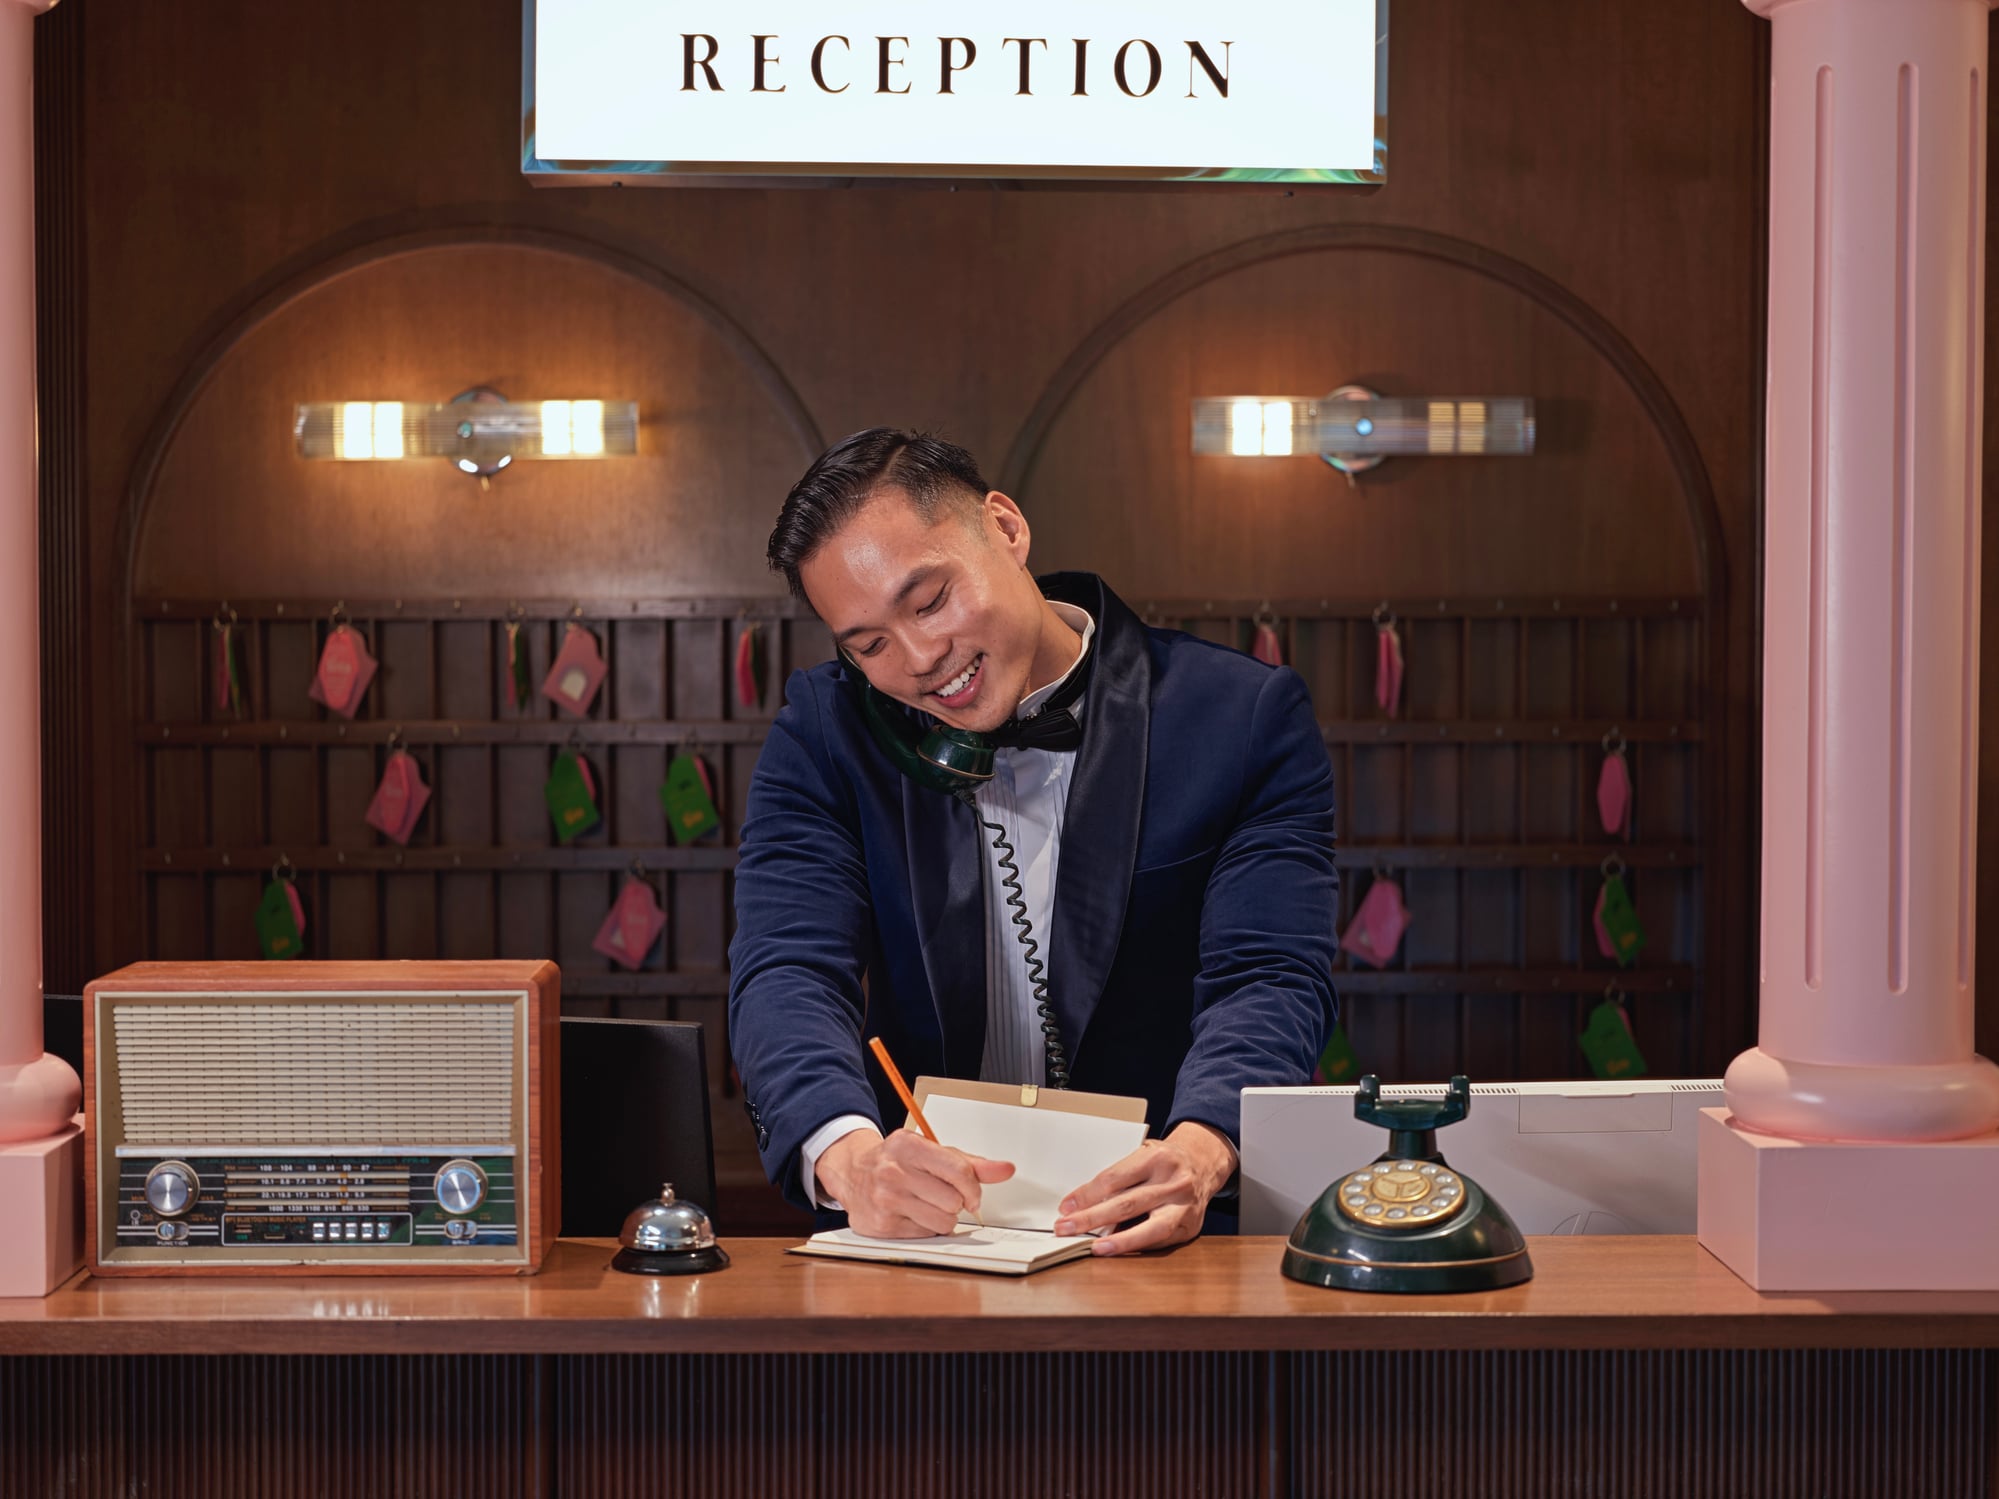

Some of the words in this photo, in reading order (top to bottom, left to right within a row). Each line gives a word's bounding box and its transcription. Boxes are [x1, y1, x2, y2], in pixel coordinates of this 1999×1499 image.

[679, 33, 1236, 99] RECEPTION
[260, 1164, 273, 1172] 108
[280, 1164, 293, 1172] 104
[361, 1164, 370, 1172] 87
